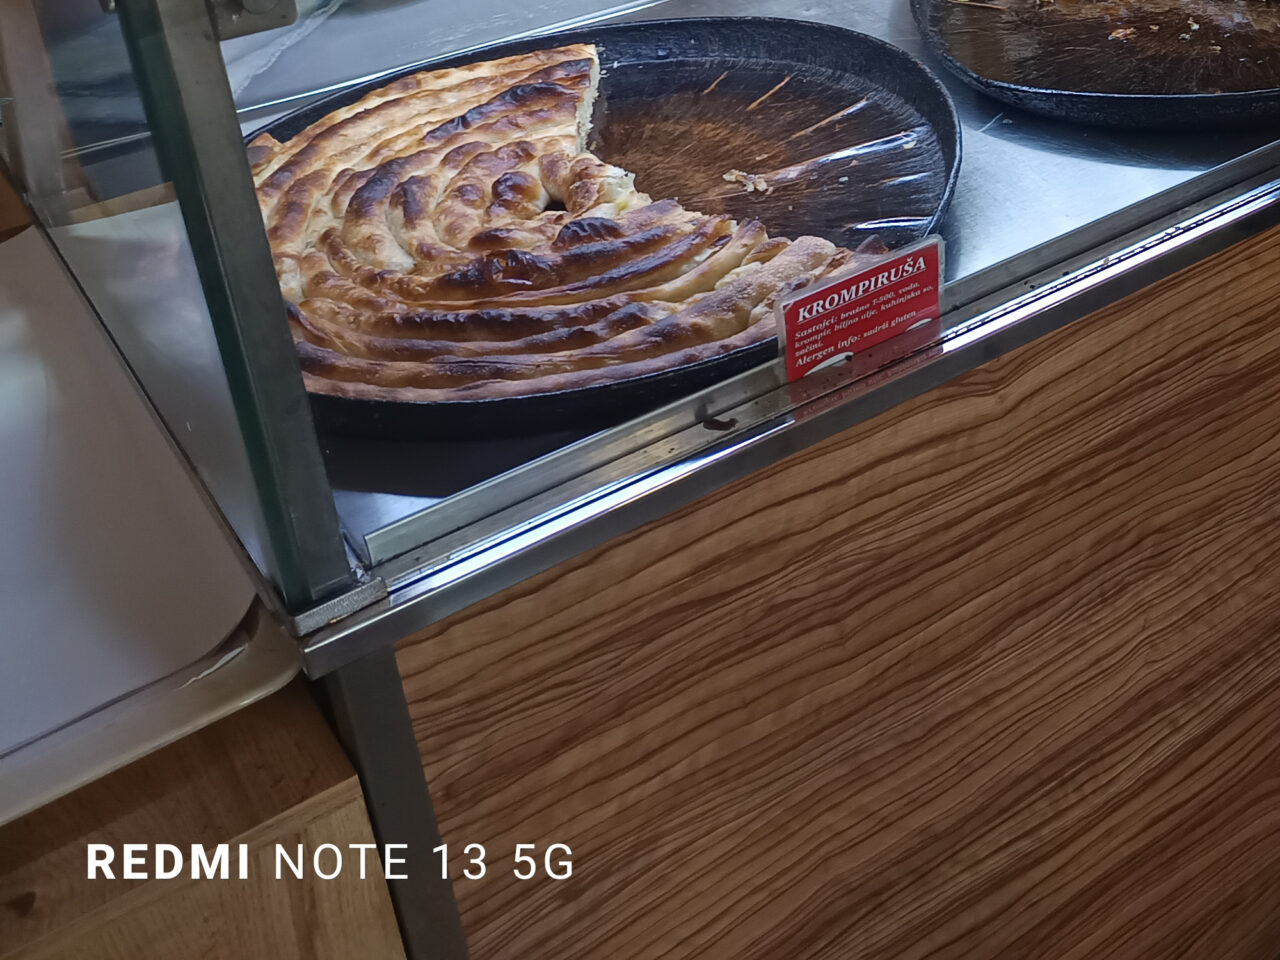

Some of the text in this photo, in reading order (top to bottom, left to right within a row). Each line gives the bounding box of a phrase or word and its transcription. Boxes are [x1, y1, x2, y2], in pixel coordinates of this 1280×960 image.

[797, 256, 926, 322] KROMPIRUŠA
[834, 315, 858, 332] biljno
[880, 288, 920, 311] kuhinjska
[795, 314, 837, 339] Sastojci:
[840, 302, 869, 319] brašno
[796, 309, 916, 368] Alergen info: sadrži gluten
